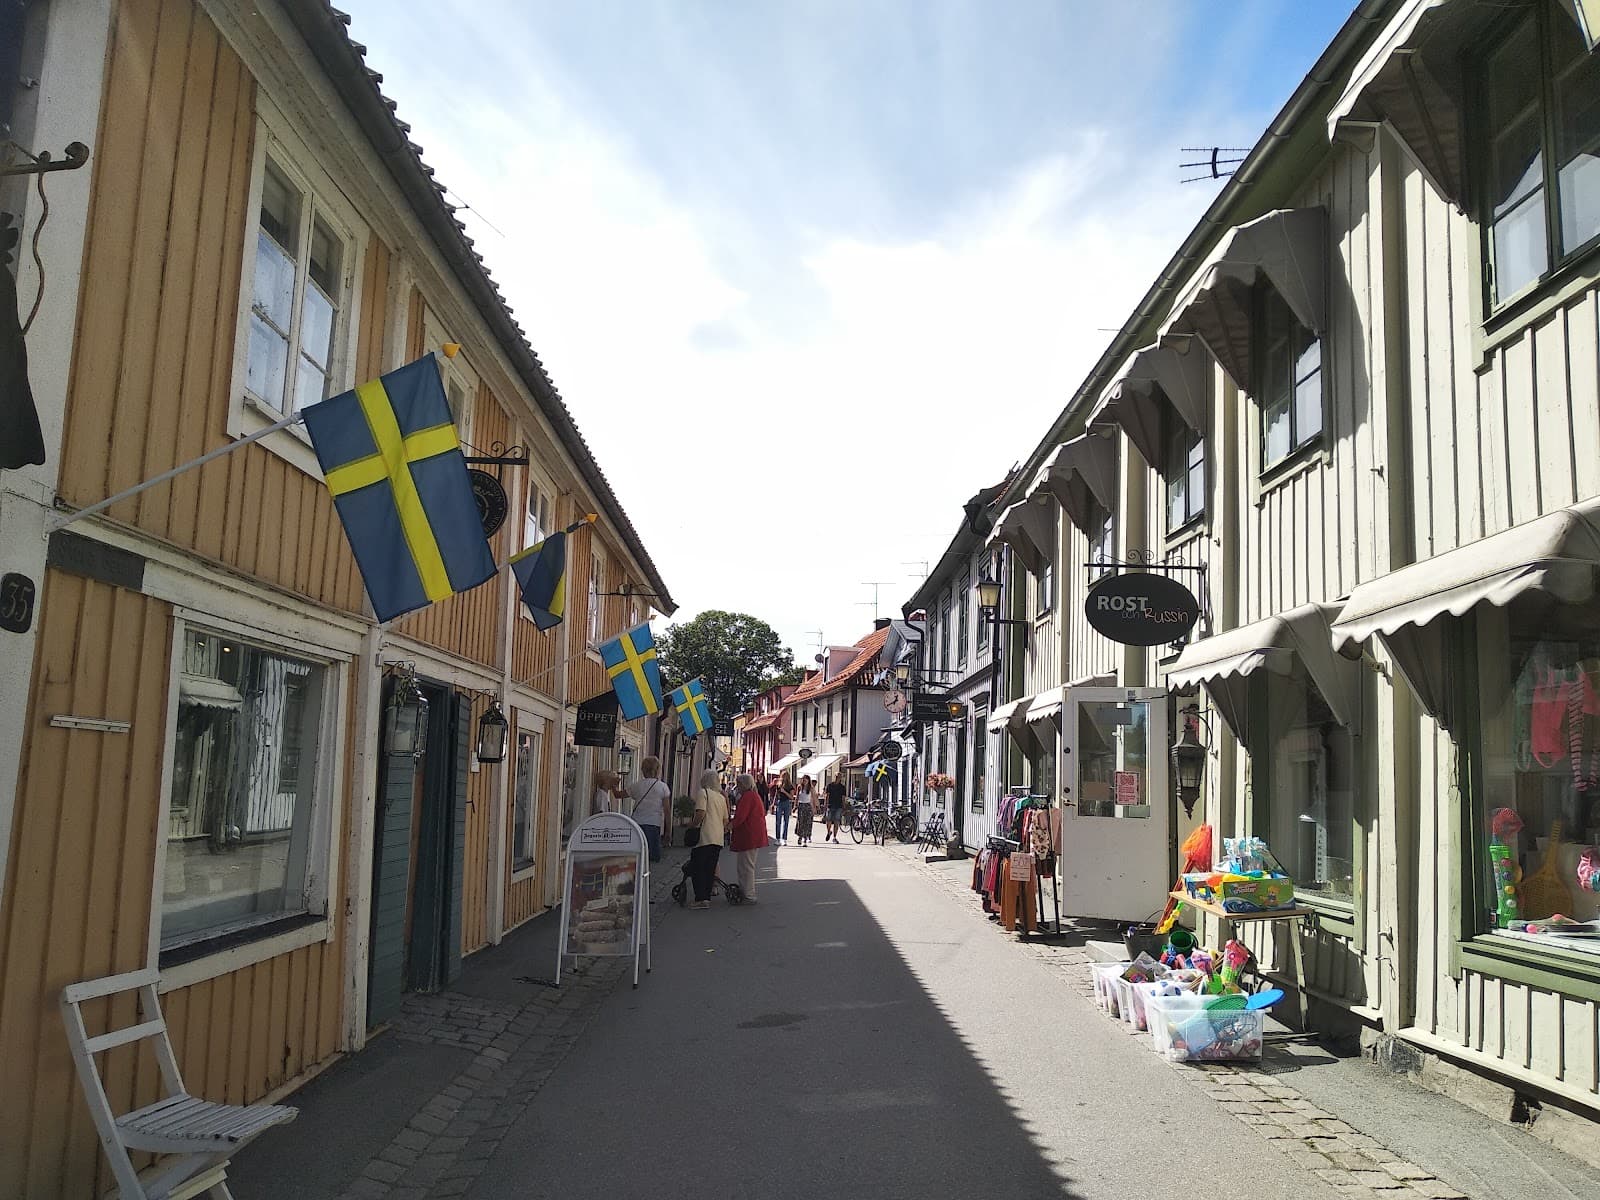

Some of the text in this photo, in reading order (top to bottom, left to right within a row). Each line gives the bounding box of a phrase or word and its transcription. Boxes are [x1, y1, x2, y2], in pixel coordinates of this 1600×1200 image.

[2, 582, 32, 622] 35
[1097, 595, 1148, 611] ROST
[1144, 607, 1188, 623] Russin
[580, 709, 616, 723] ÖPPET
